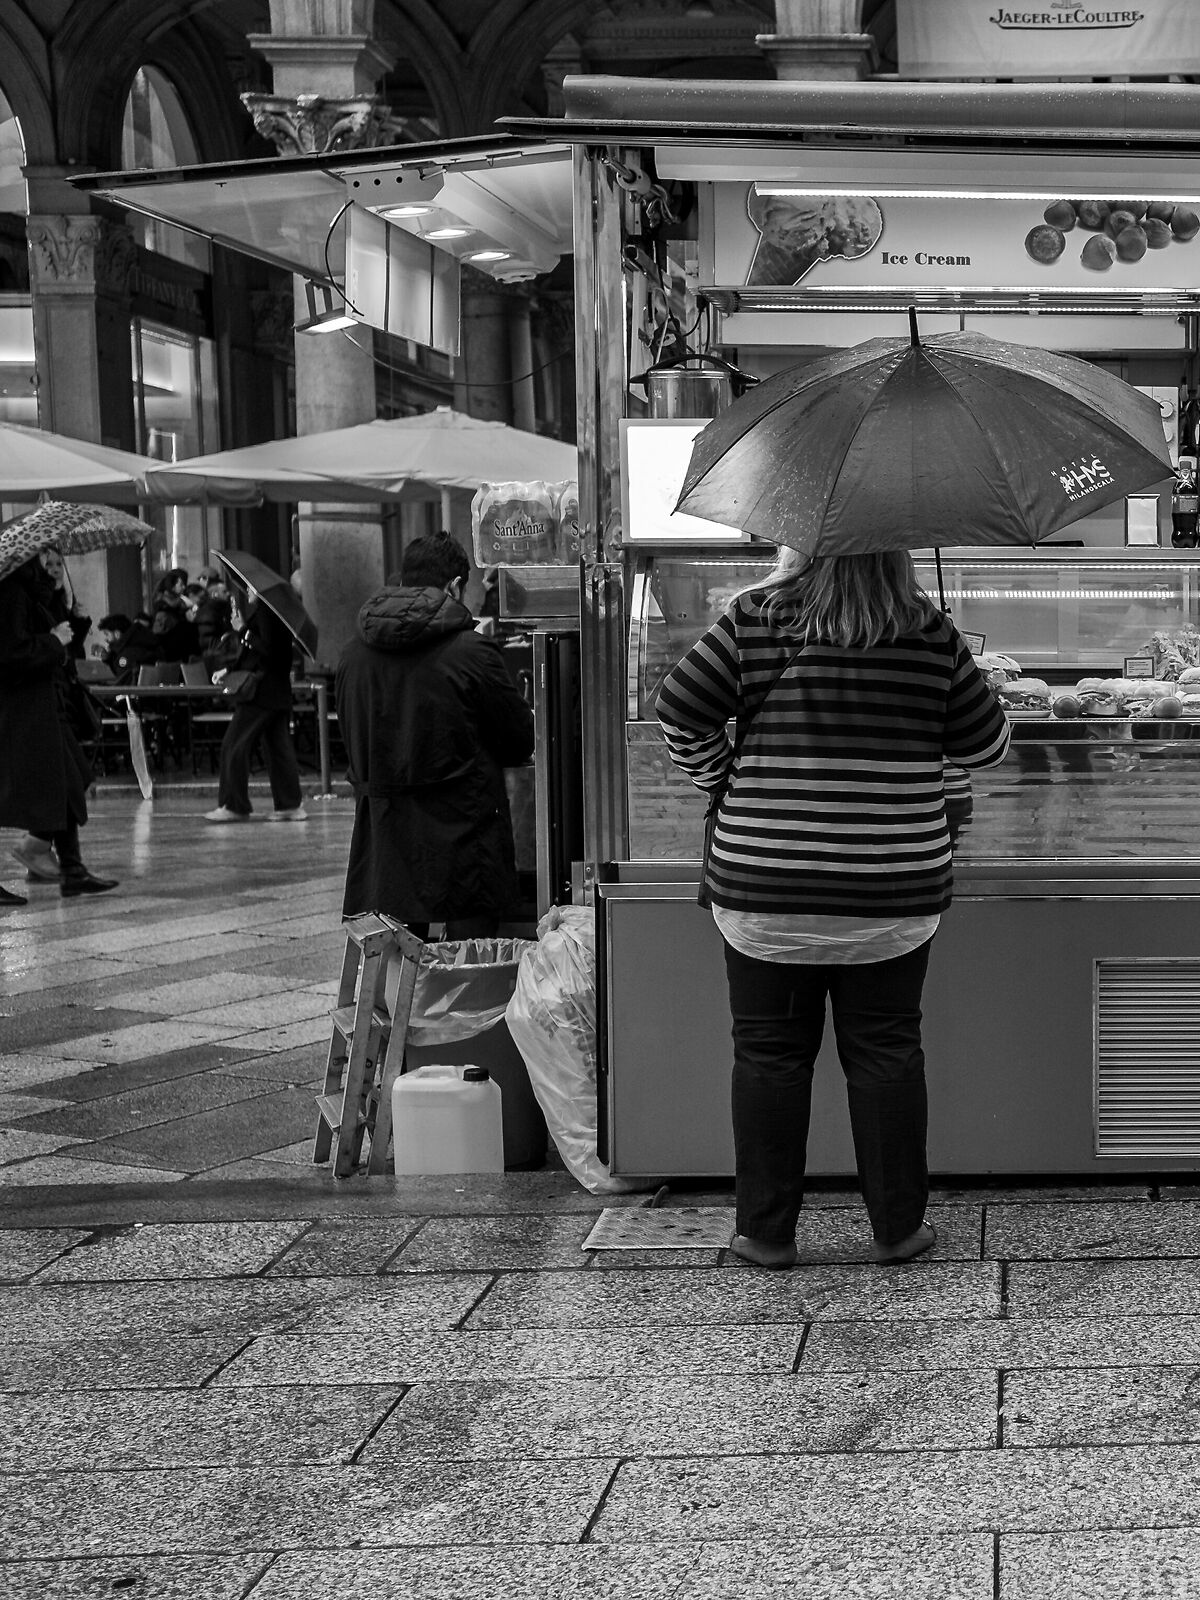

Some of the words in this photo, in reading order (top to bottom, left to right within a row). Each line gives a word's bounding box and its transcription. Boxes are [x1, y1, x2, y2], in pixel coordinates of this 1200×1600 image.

[881, 252, 908, 265] Ice
[914, 252, 971, 266] Cream
[1050, 453, 1097, 477] HOTEL
[1070, 459, 1111, 489] HMS
[494, 519, 545, 537] Sant'Anna
